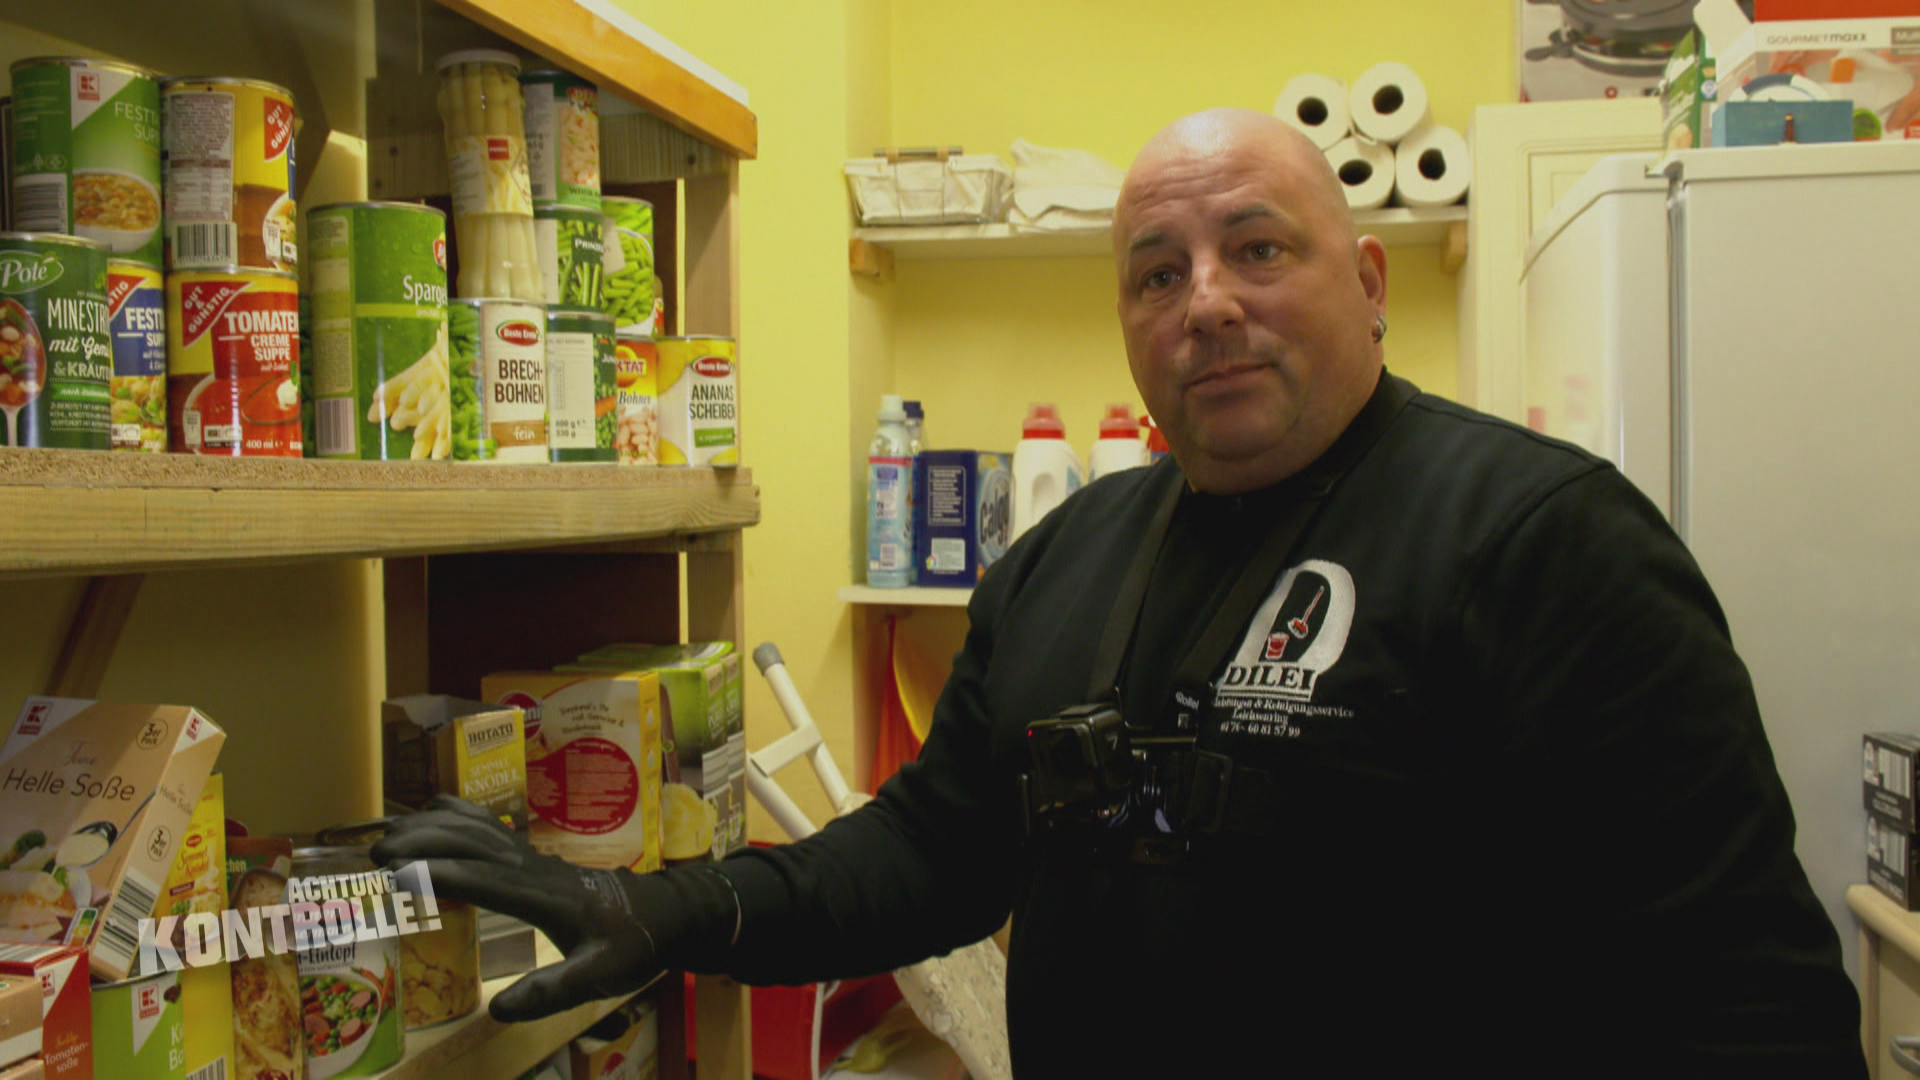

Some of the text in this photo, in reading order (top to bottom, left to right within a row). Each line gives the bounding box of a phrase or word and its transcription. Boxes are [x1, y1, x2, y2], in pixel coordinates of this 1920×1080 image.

[49, 337, 79, 353] mit
[250, 334, 290, 348] CREME
[254, 348, 291, 361] SUPPE
[54, 361, 67, 377] &
[498, 358, 543, 381] BRECH-
[494, 383, 544, 405] BOHNEN
[691, 384, 734, 400] ANANAS
[1223, 665, 1317, 690] DILEI
[3, 768, 136, 801] Helle Soße
[44, 1041, 89, 1066] Tomaten-
